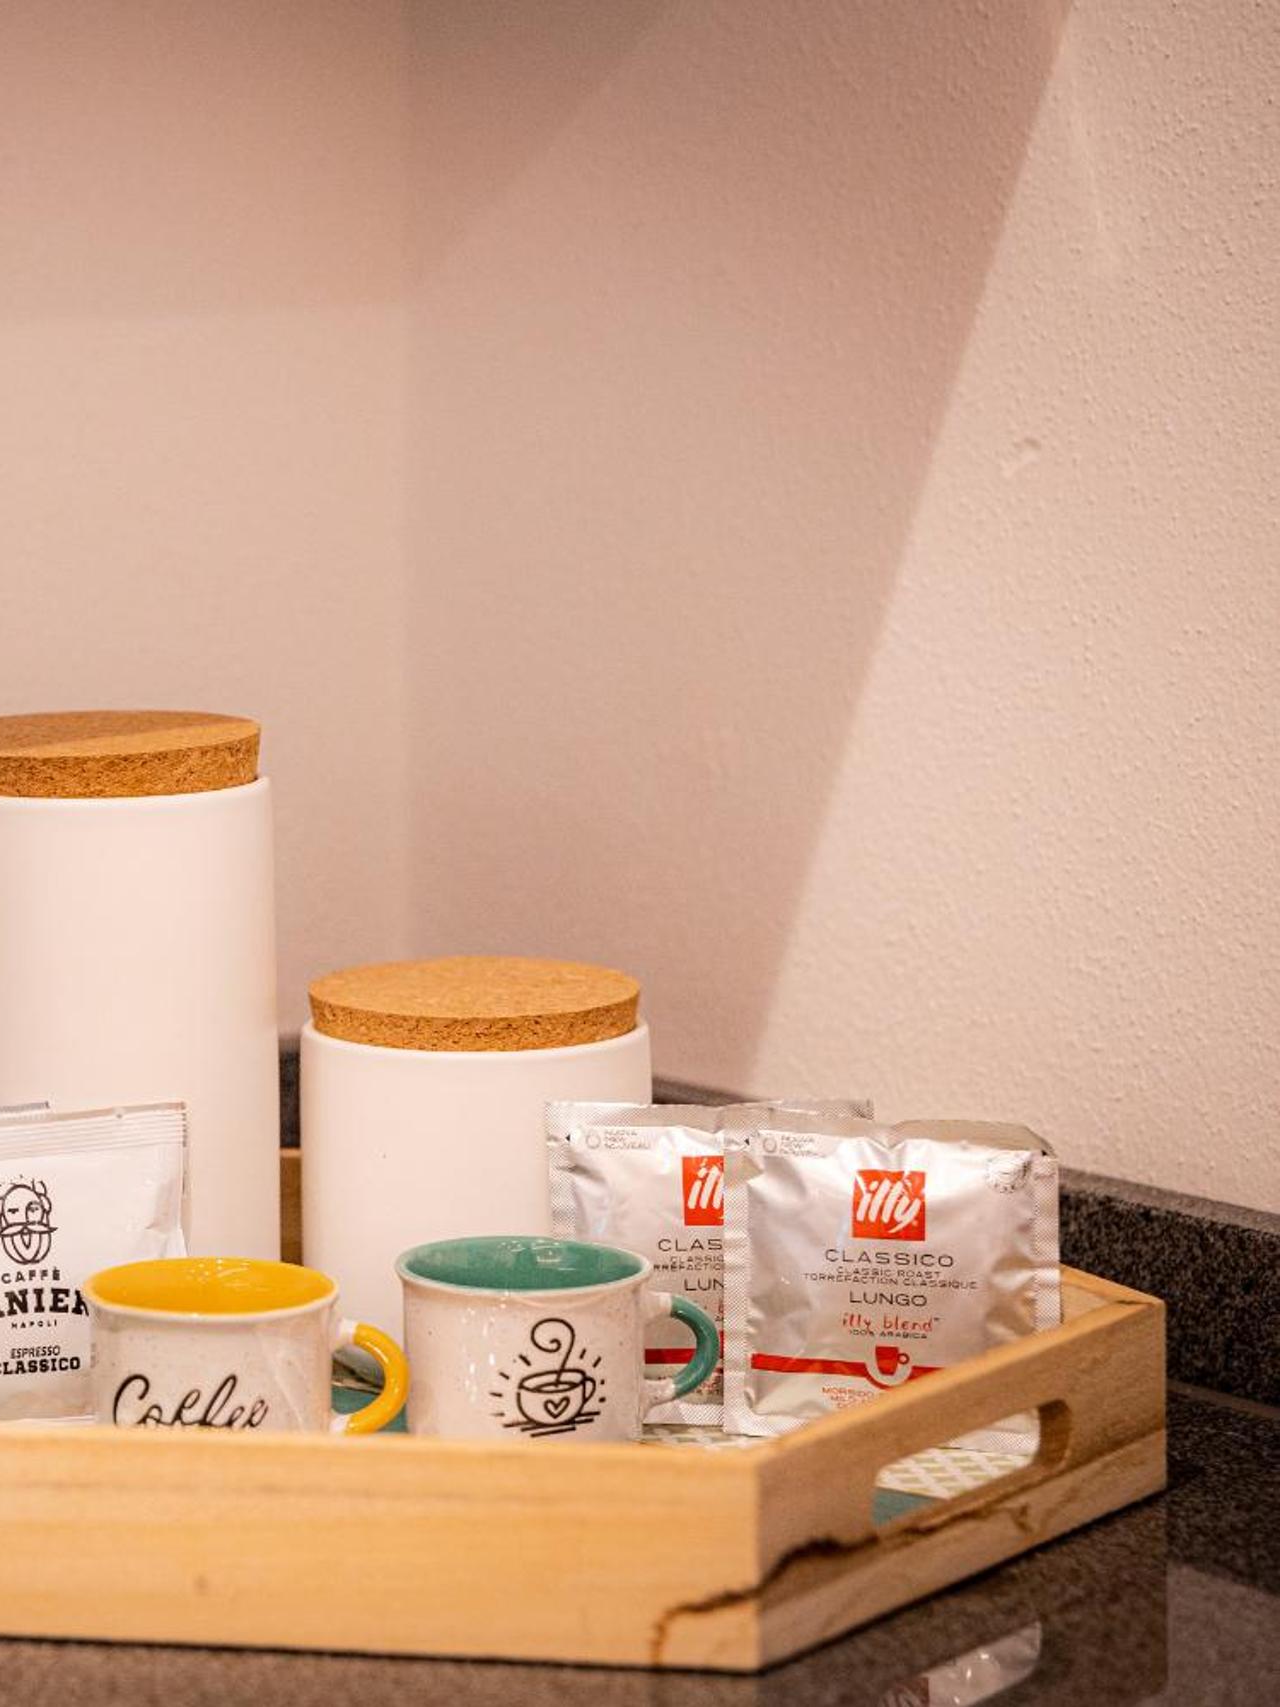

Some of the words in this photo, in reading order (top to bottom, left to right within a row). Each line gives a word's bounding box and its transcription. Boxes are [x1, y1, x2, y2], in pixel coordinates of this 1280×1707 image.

[856, 1178, 921, 1234] illy
[658, 1238, 723, 1252] CLAS
[825, 1249, 954, 1268] CLASSICO
[1, 1267, 61, 1284] CAFFÈ
[836, 1266, 892, 1277] CLASSIC
[897, 1270, 941, 1279] ROAST
[902, 1278, 978, 1289] CLASSIQUE
[849, 1291, 928, 1307] LUNGO
[11, 1319, 58, 1329] NAPOLI
[842, 1312, 871, 1333] illy
[10, 1345, 61, 1359] ESPRESSO
